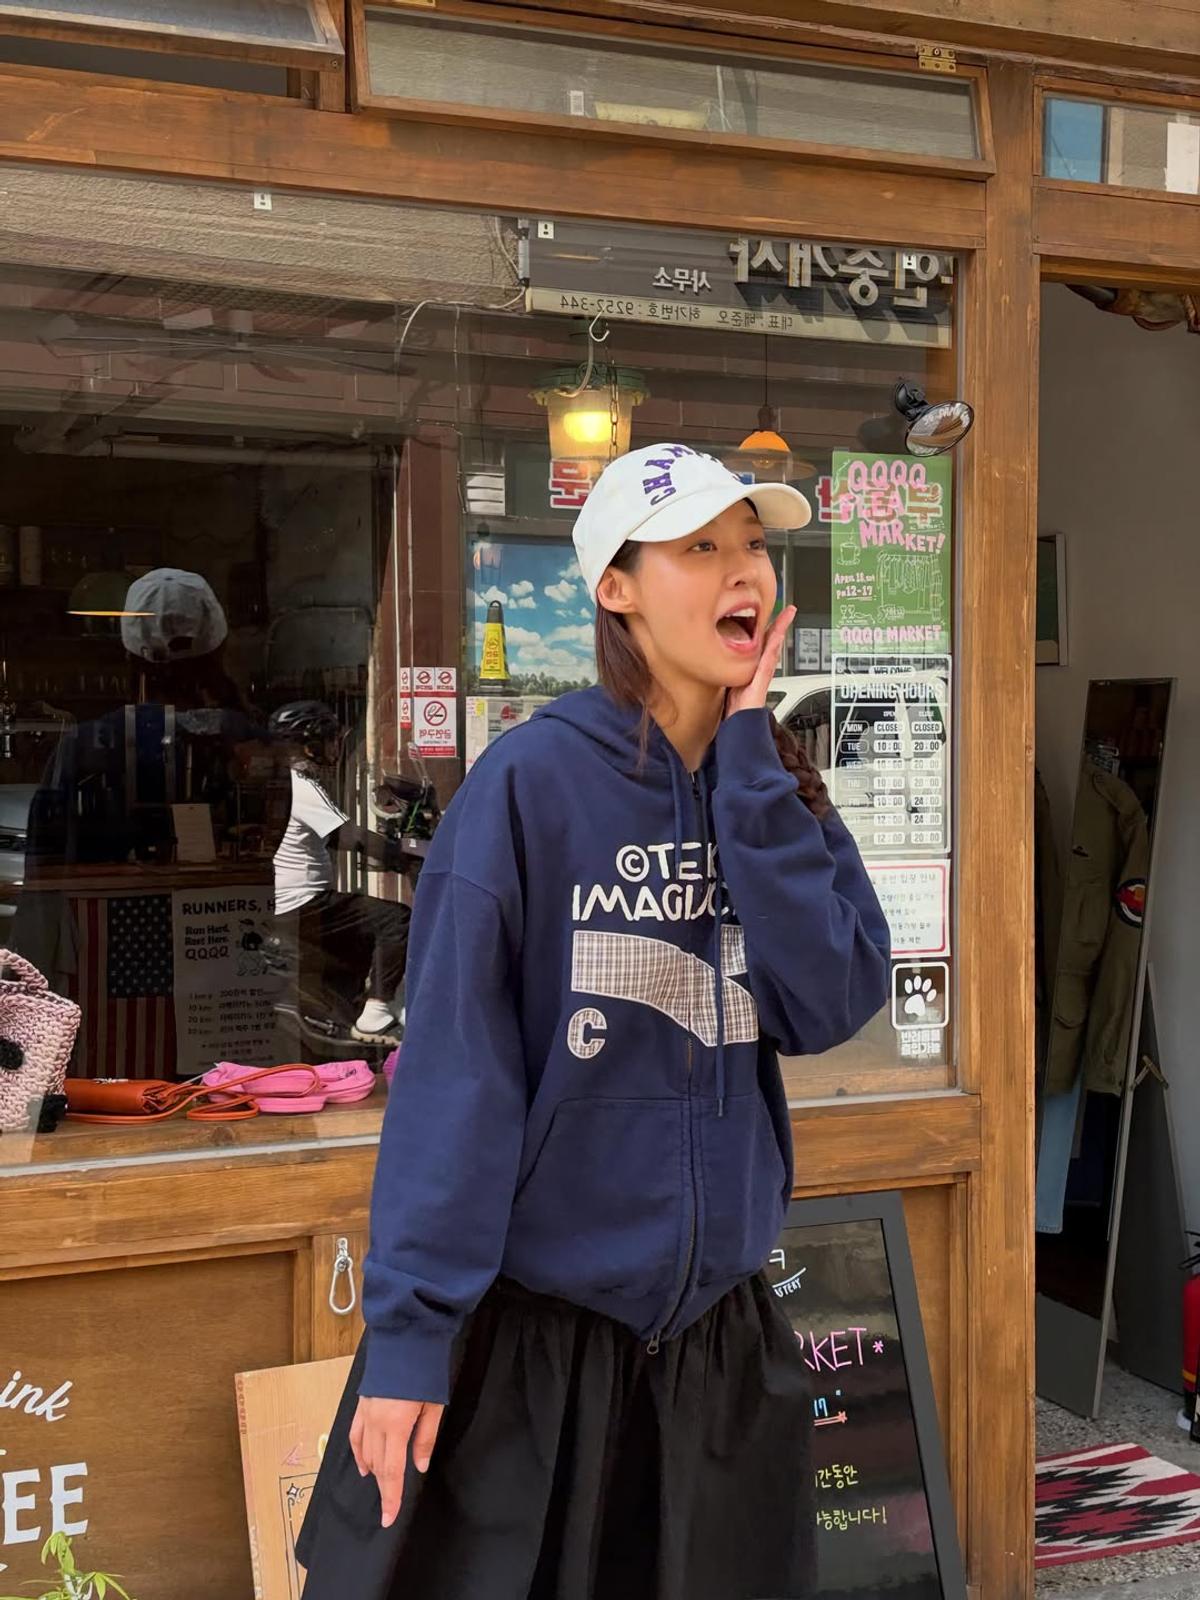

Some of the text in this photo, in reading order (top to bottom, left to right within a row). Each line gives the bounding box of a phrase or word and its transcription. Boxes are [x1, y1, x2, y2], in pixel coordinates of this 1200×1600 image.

[849, 460, 926, 493] QQQQ
[858, 520, 946, 555] MARKET!
[887, 624, 942, 643] MARKET
[841, 682, 944, 699] OPENING HOURS
[876, 723, 902, 732] CLOSE
[914, 723, 940, 732] CLOSED
[182, 900, 262, 915] RUNNERS,
[185, 946, 230, 961] QQQQ
